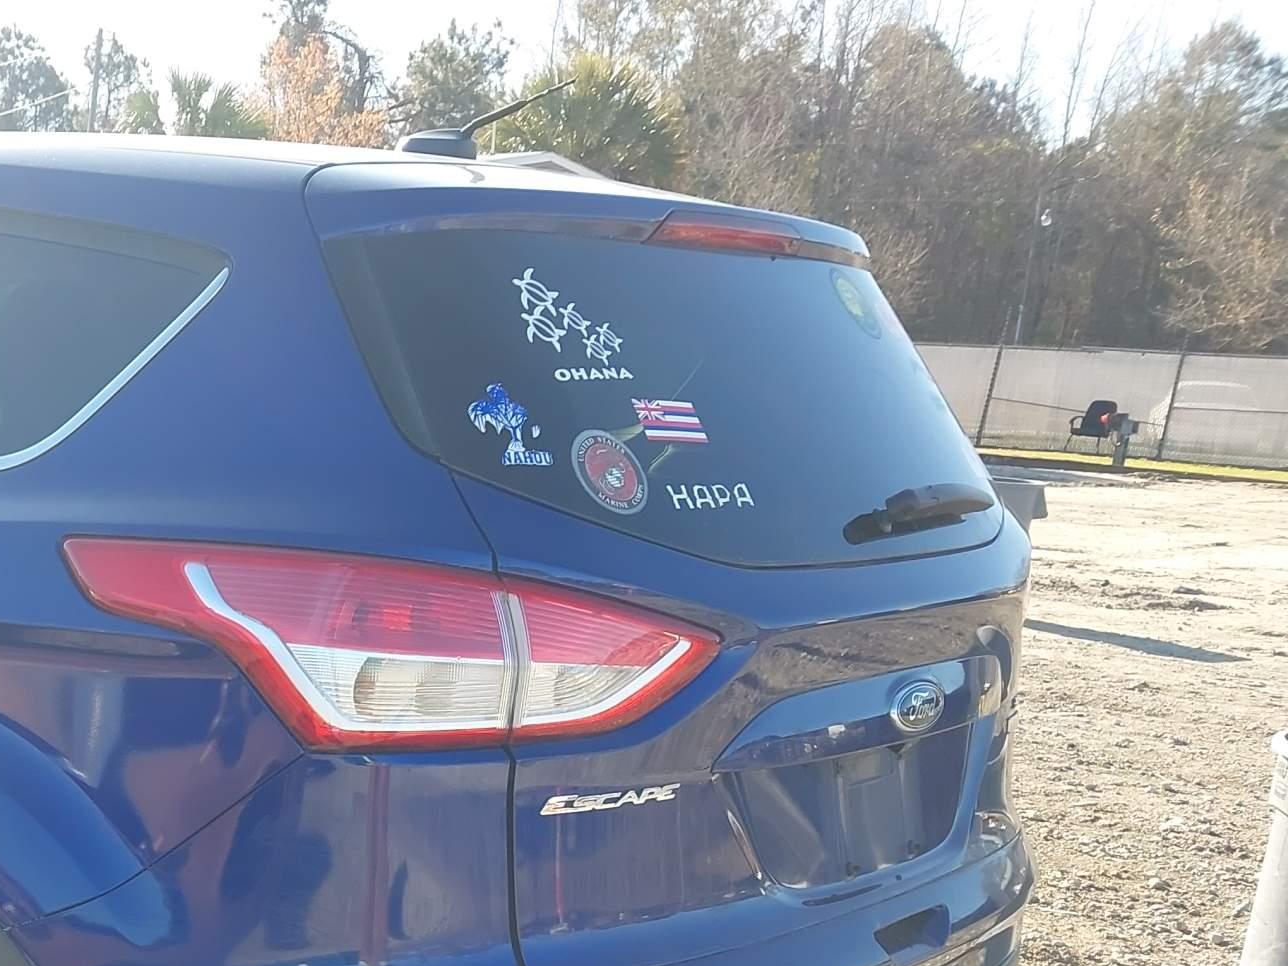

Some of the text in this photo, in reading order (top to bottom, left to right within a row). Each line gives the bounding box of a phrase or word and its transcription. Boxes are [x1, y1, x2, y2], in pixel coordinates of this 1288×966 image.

[554, 367, 634, 381] OHANA
[665, 483, 755, 509] HAPA
[540, 783, 681, 816] ESCAPE
